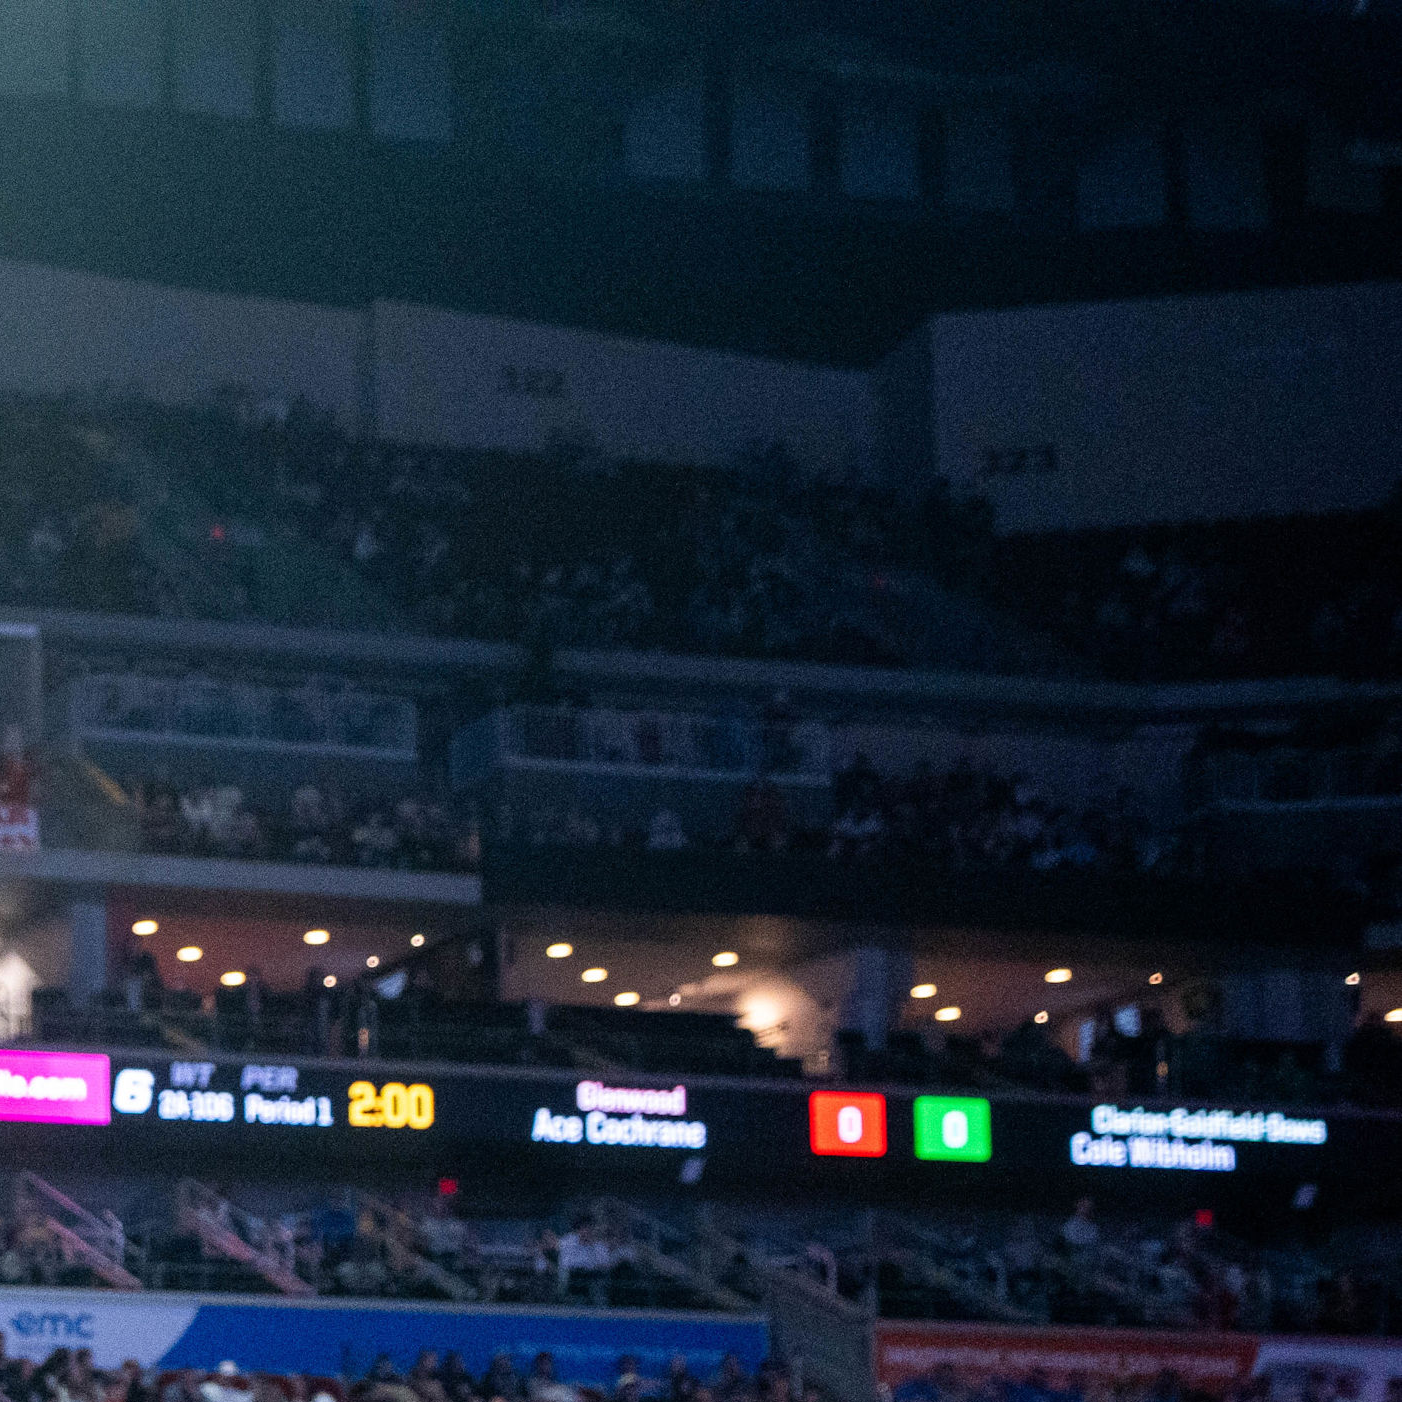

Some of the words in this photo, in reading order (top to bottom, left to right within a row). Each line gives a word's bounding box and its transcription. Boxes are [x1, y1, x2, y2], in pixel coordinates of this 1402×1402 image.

[114, 1069, 154, 1111] 6
[170, 1061, 214, 1089] WT
[241, 1064, 298, 1093] PER
[246, 1094, 316, 1123] Period
[319, 1097, 332, 1125] 1
[348, 1080, 436, 1130] 2:00
[534, 1108, 583, 1141] Ace
[587, 1111, 707, 1147] Cochrane
[838, 1106, 864, 1143] 0
[943, 1111, 968, 1148] 0
[1072, 1133, 1126, 1165] Cole
[10, 1309, 95, 1340] emc
